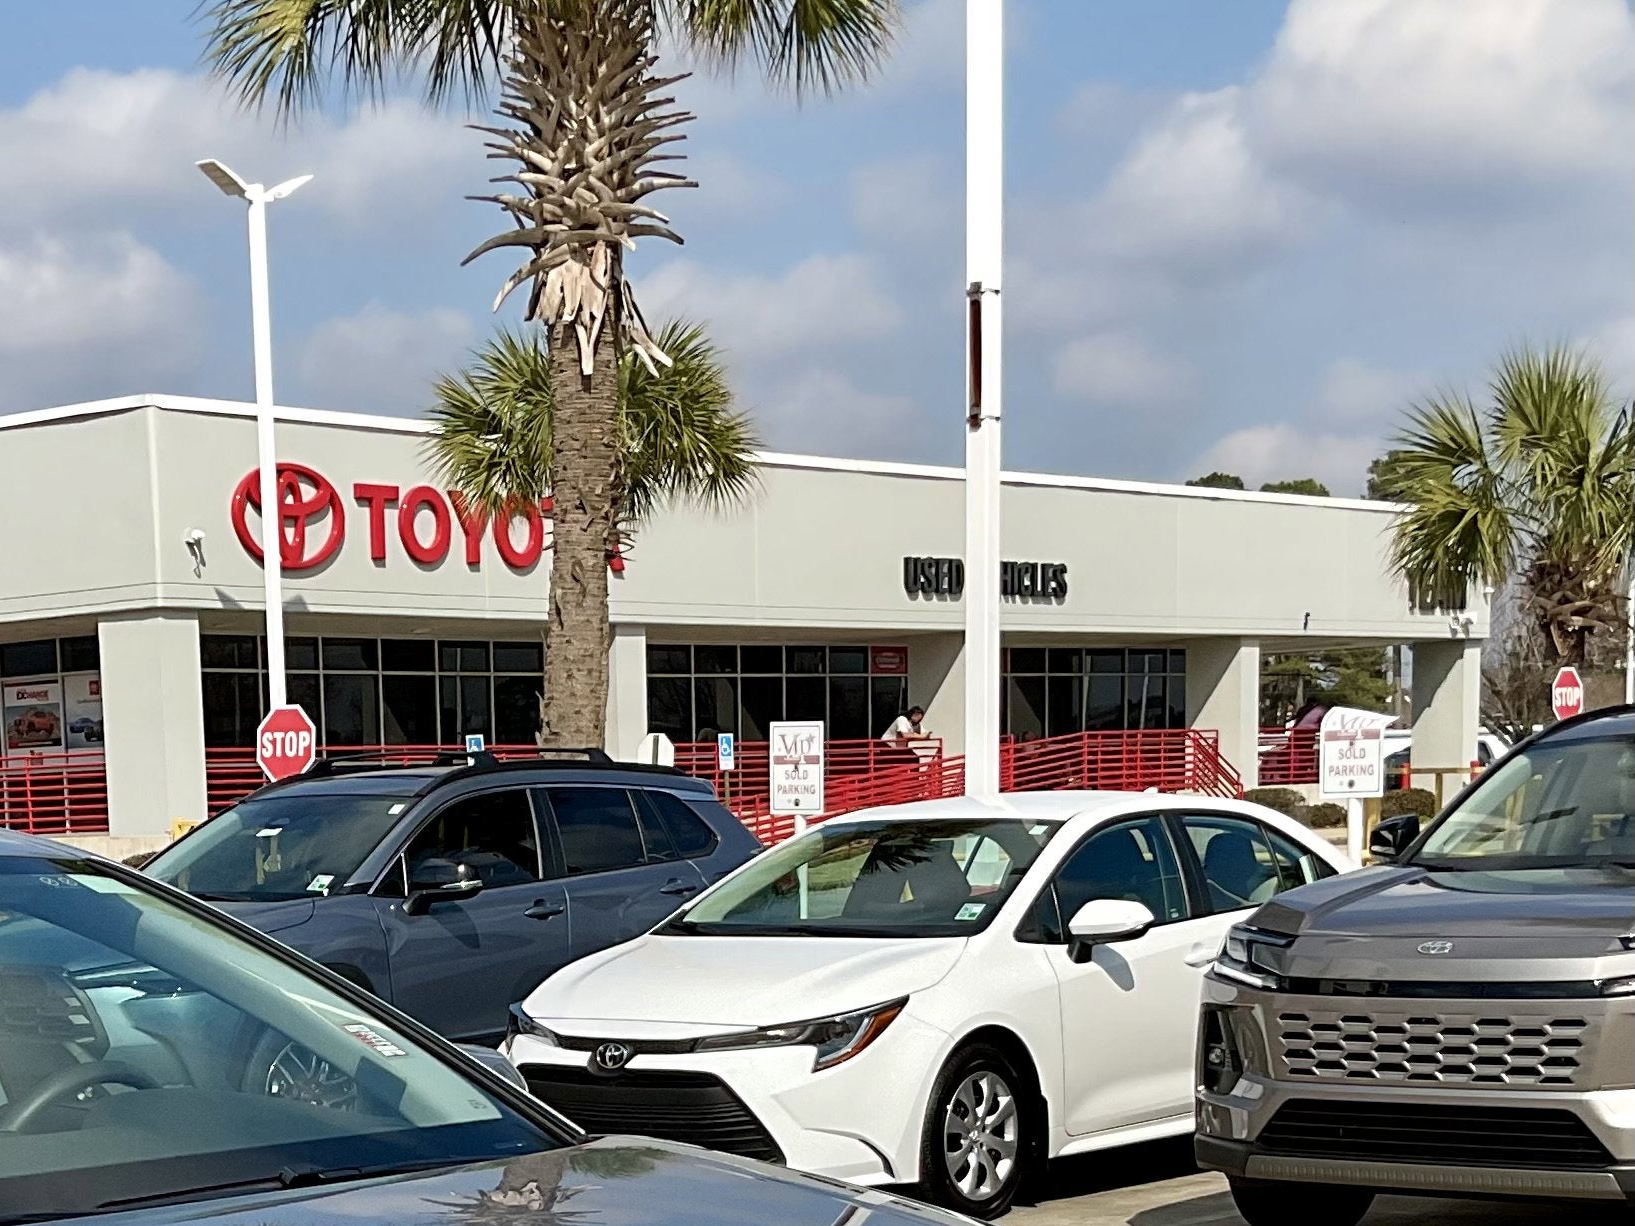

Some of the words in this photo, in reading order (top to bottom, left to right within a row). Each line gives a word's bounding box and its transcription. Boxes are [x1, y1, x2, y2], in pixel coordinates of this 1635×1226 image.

[354, 483, 625, 572] TOYO
[903, 557, 965, 593] USED
[1000, 561, 1068, 598] HICLES
[1555, 686, 1580, 707] STOP
[261, 730, 311, 758] STOP
[1338, 748, 1367, 760] SOLD
[784, 769, 809, 780] SOLD
[1328, 764, 1375, 777] PARKING
[777, 784, 816, 795] PARKING
